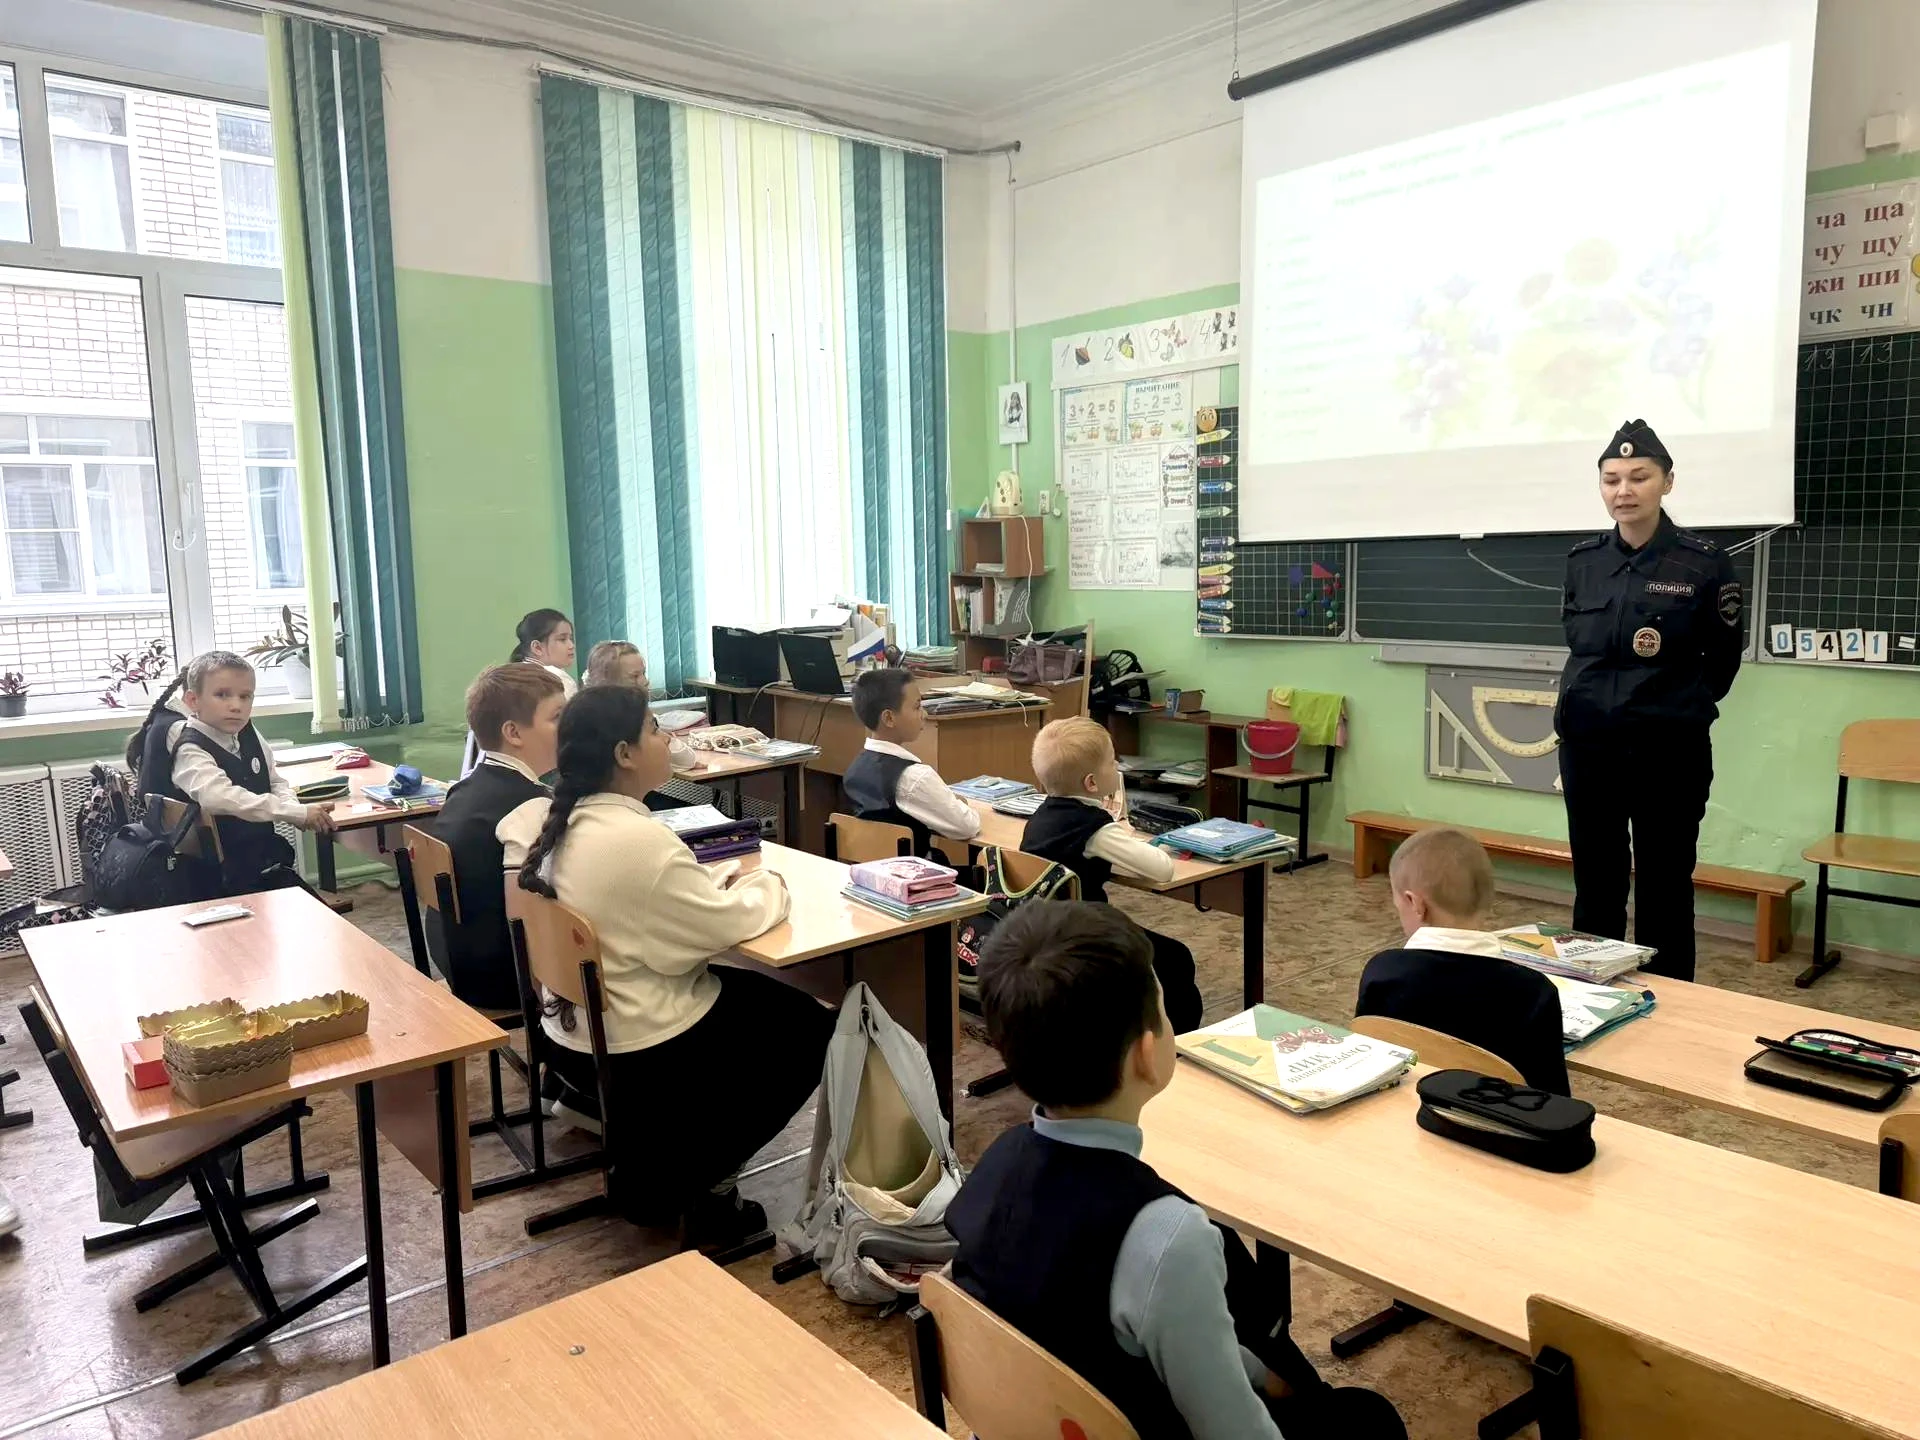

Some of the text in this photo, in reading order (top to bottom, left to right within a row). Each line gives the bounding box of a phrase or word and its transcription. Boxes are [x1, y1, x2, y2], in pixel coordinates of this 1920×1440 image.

[1816, 202, 1904, 229] ча ща
[1815, 235, 1903, 265] чу щу
[1807, 269, 1900, 295] жи ши
[1809, 302, 1894, 325] чк чн
[1104, 337, 1114, 361] 2
[1146, 329, 1160, 352] 3
[1200, 319, 1212, 344] 4
[1069, 405, 1077, 417] 3
[1087, 402, 1095, 415] 2
[1108, 399, 1116, 413] 5
[1133, 397, 1140, 411] 5
[1151, 395, 1160, 409] 2
[1174, 392, 1182, 406] 3
[1648, 583, 1692, 594] ПОЛИЦИЯ
[1776, 631, 1788, 650] 0
[1800, 633, 1813, 652] 5
[1821, 634, 1834, 653] 4
[1846, 632, 1859, 652] 2
[1872, 634, 1880, 654] 1
